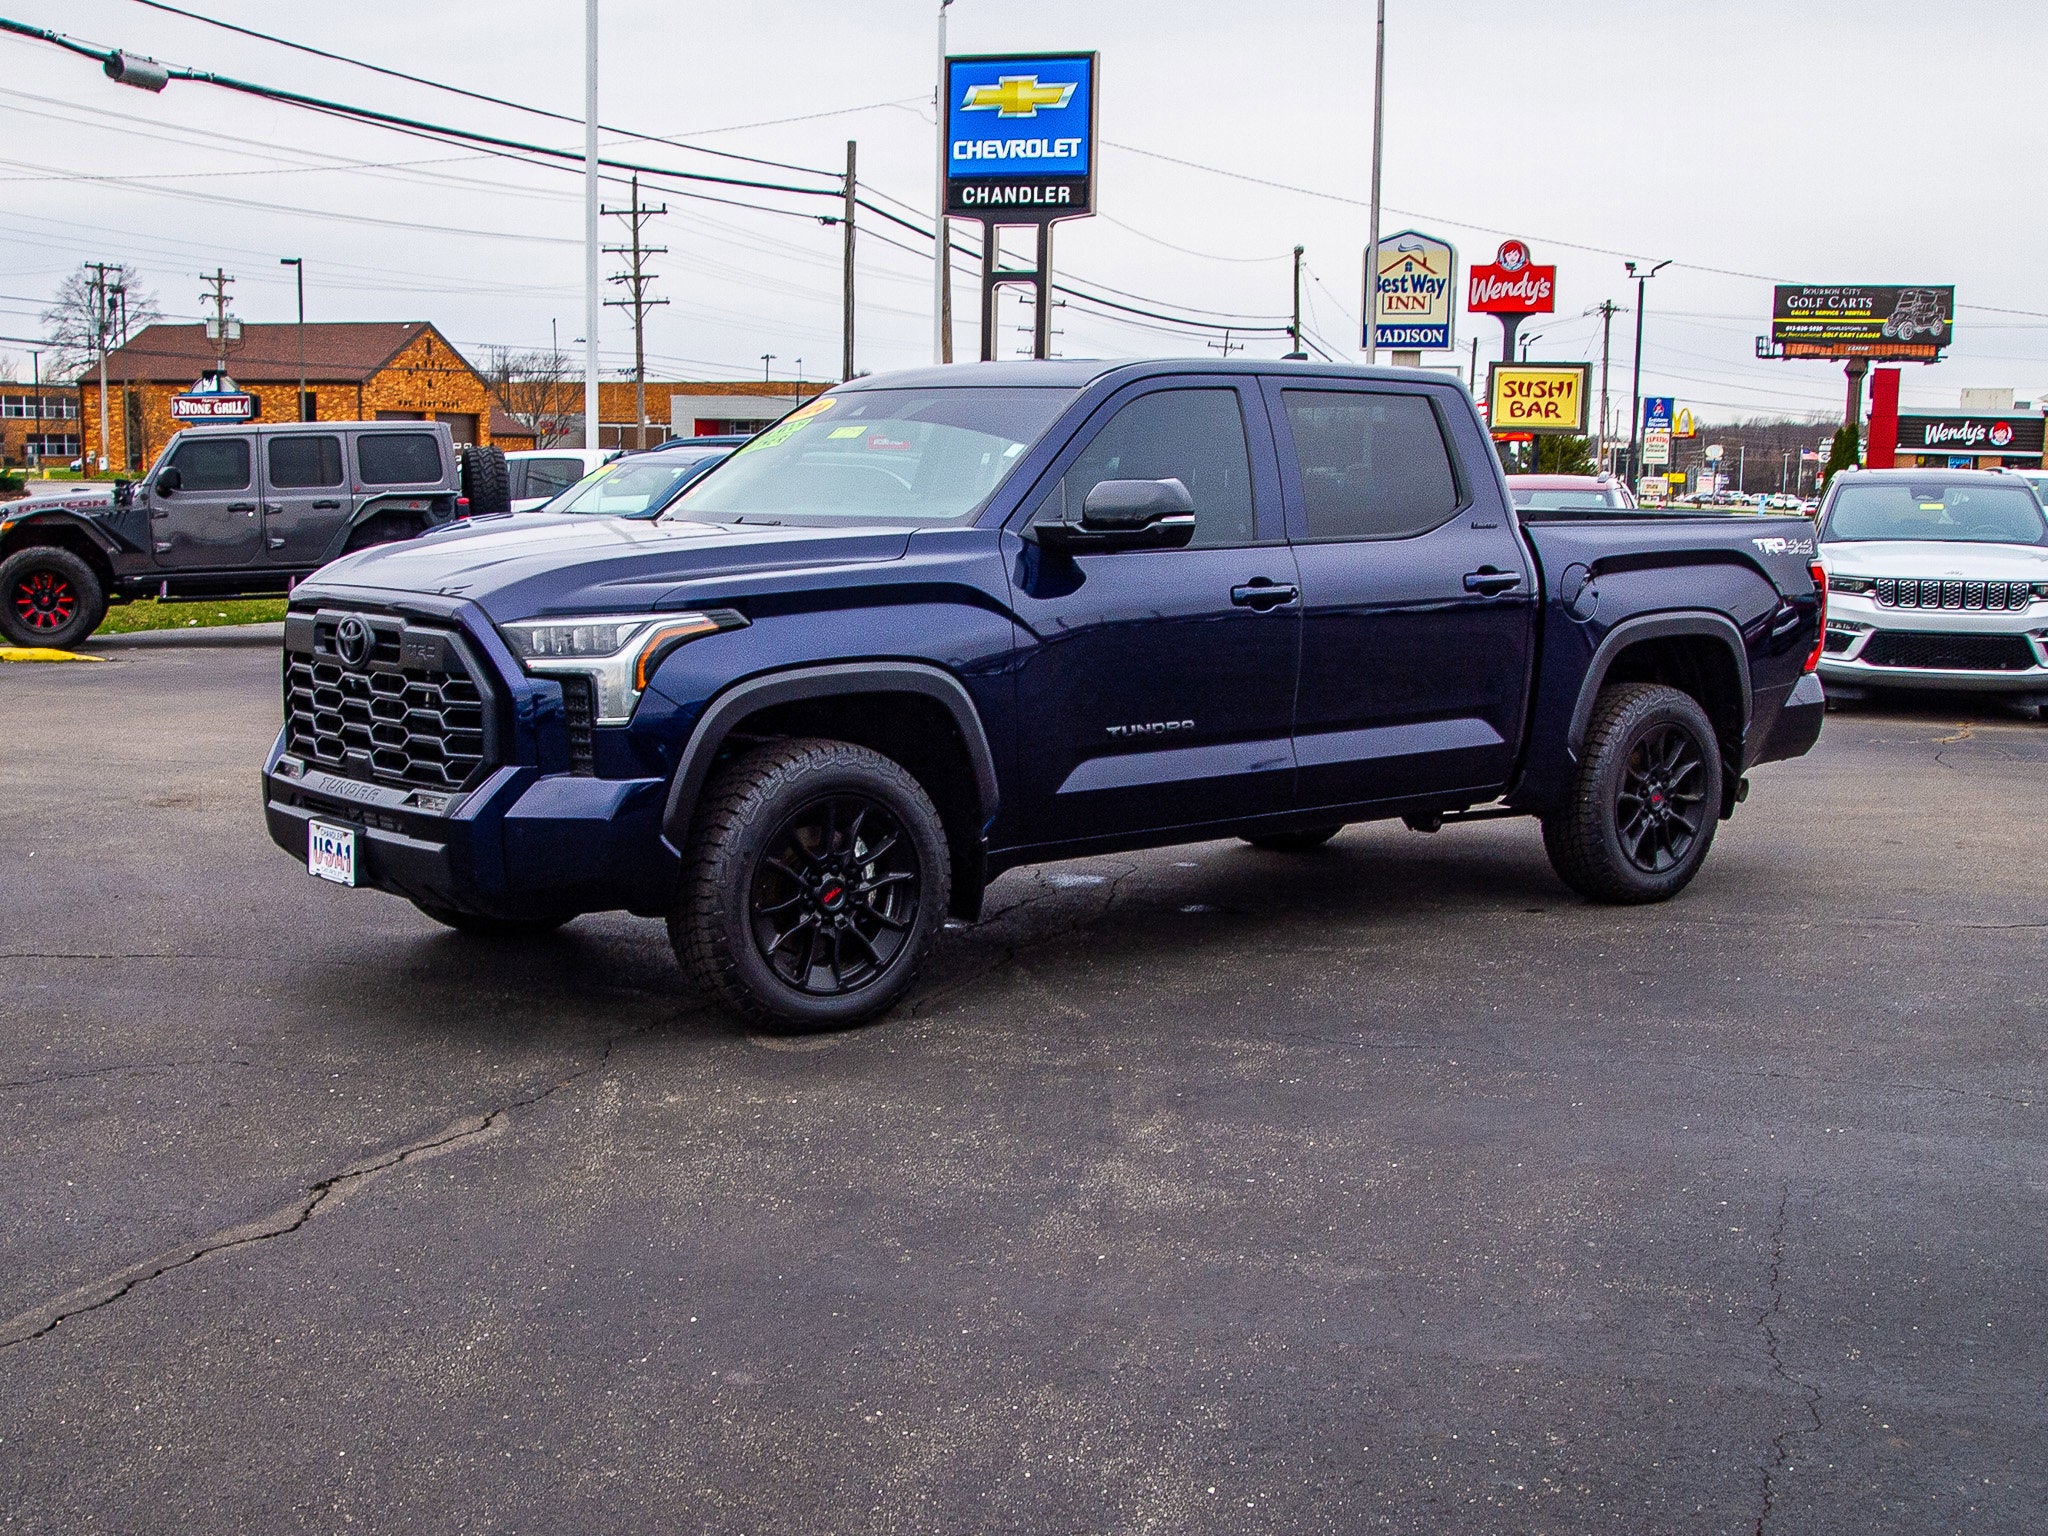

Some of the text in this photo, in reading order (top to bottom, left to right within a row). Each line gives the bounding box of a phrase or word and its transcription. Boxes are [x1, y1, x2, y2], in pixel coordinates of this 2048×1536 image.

[952, 138, 1082, 160] CHEVROLET
[962, 186, 1071, 204] CHANDLER
[1410, 274, 1447, 300] Way
[1470, 271, 1551, 306] Wendy's
[1386, 295, 1427, 310] INN
[1787, 295, 1873, 309] GOLF CARTS
[1503, 380, 1573, 399] SUSHI
[178, 400, 244, 415] STONE GRILL
[1509, 400, 1562, 419] BAR
[1925, 421, 1985, 446] Wendy's
[1752, 537, 1786, 554] TRD
[1105, 719, 1195, 737] TUNDRA
[318, 776, 382, 801] TUNDRA
